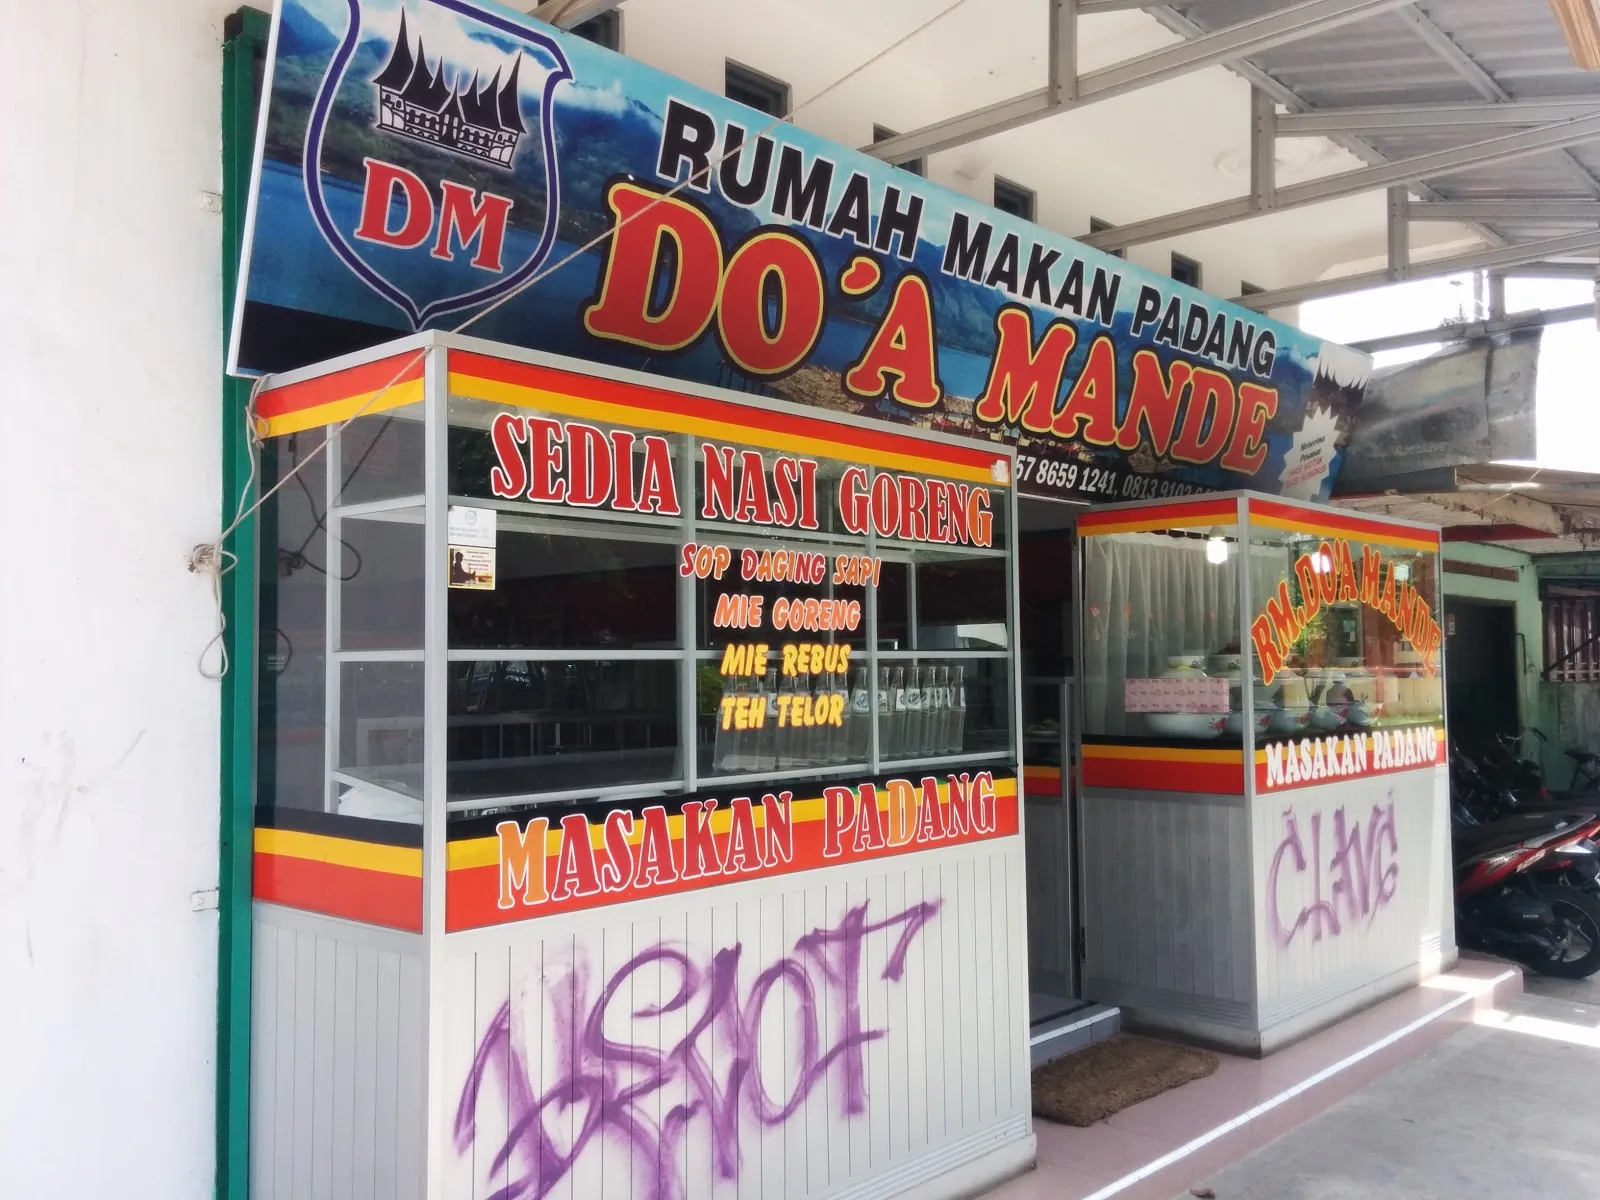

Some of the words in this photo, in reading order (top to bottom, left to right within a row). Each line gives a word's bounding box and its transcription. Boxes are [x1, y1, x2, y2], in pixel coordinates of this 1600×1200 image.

[355, 157, 513, 273] DM
[656, 96, 925, 262] RUMAH
[942, 211, 1122, 328] MAKAN
[1130, 283, 1277, 378] PADANG
[581, 179, 943, 411] DO'A
[975, 306, 1279, 476] MANDE
[491, 412, 681, 516] SEDIA
[702, 443, 820, 531] NASI
[839, 463, 993, 549] GORENG
[1036, 459, 1078, 488] 8659
[680, 542, 730, 579] SOP
[741, 549, 825, 584] DAGING
[832, 553, 881, 588] SAPI
[714, 594, 763, 629] MIE
[772, 596, 861, 632] GORENG
[1360, 544, 1442, 678] MANDE
[720, 643, 769, 677] MIE
[782, 642, 851, 677] REBUS
[720, 696, 767, 731] TEH
[776, 693, 846, 728] TELOR
[1265, 733, 1368, 788] MASAKAN
[1372, 726, 1438, 770] PADANG
[497, 791, 793, 909] MASAKAN
[823, 771, 996, 858] PADANG
